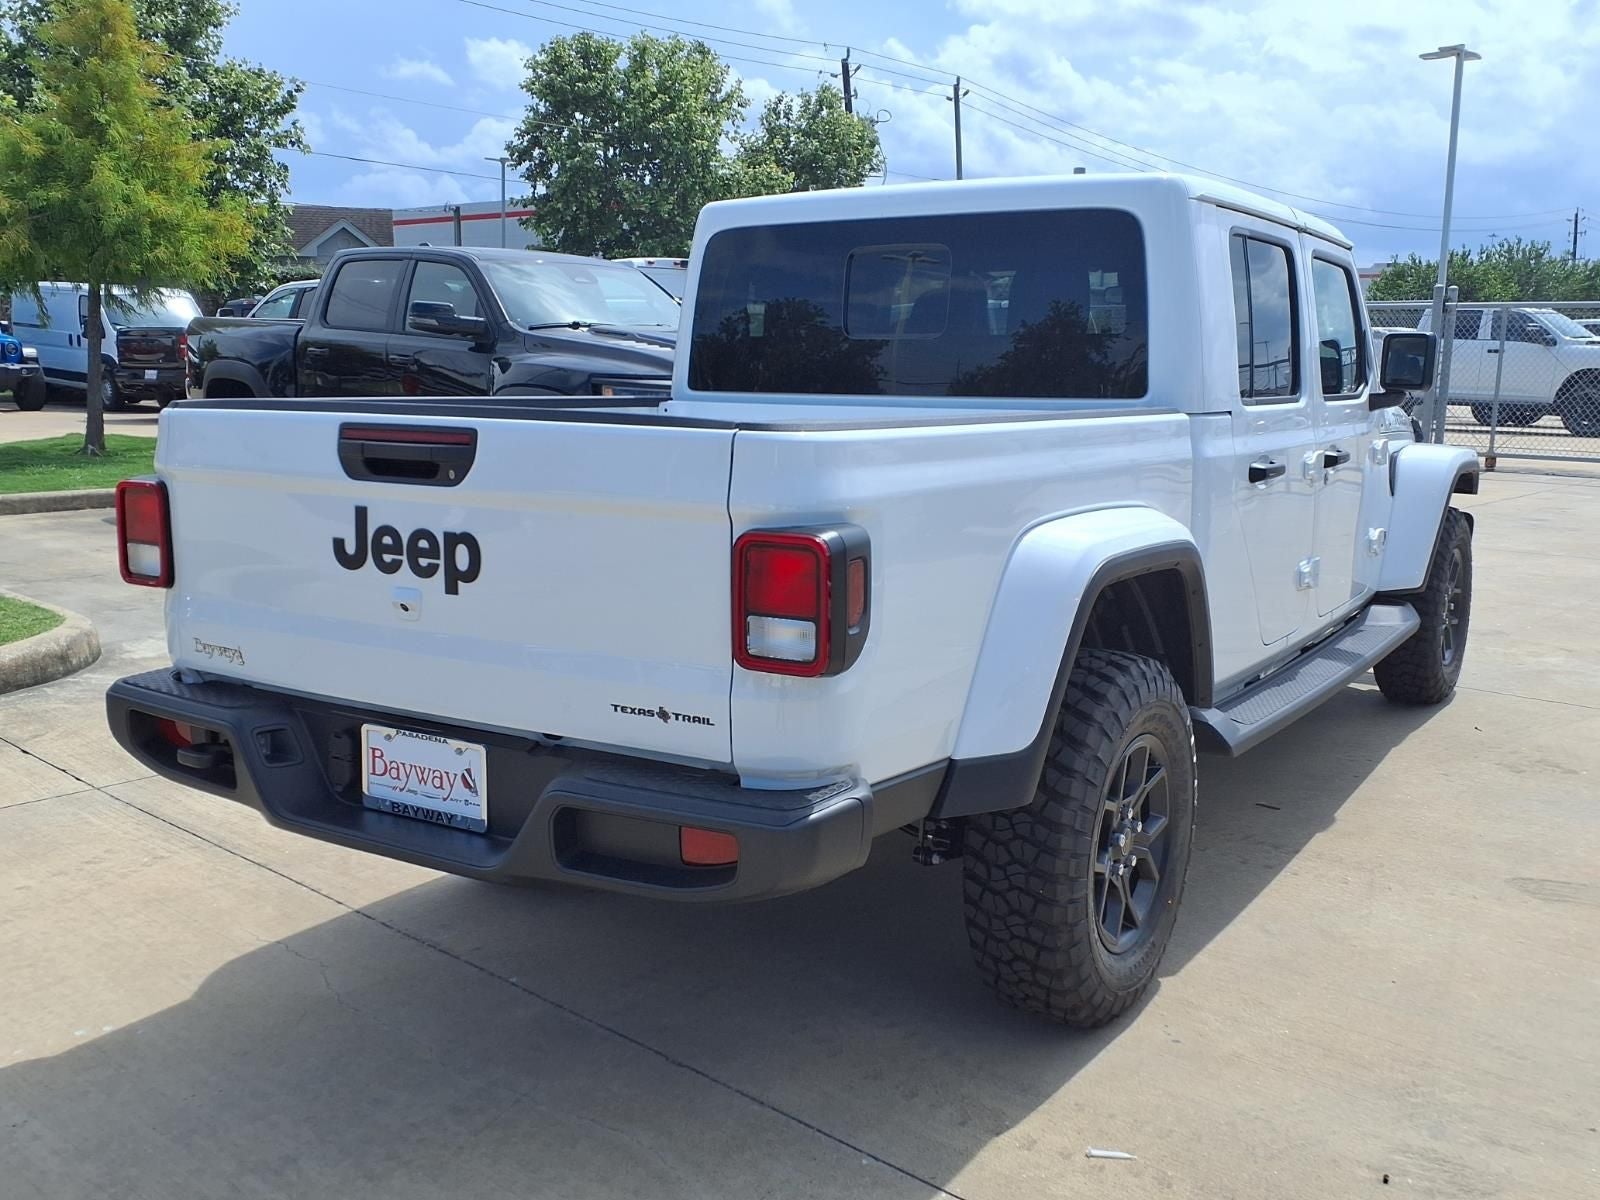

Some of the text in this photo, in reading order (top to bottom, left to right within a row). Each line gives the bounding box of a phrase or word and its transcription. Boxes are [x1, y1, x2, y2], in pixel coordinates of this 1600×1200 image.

[332, 505, 482, 596] Jeep
[193, 637, 237, 664] Bayway
[610, 703, 716, 726] TEXAS TRAIL
[396, 729, 449, 745] PASADENA
[369, 747, 458, 802] Bayway
[391, 801, 454, 825] BAYWAY
